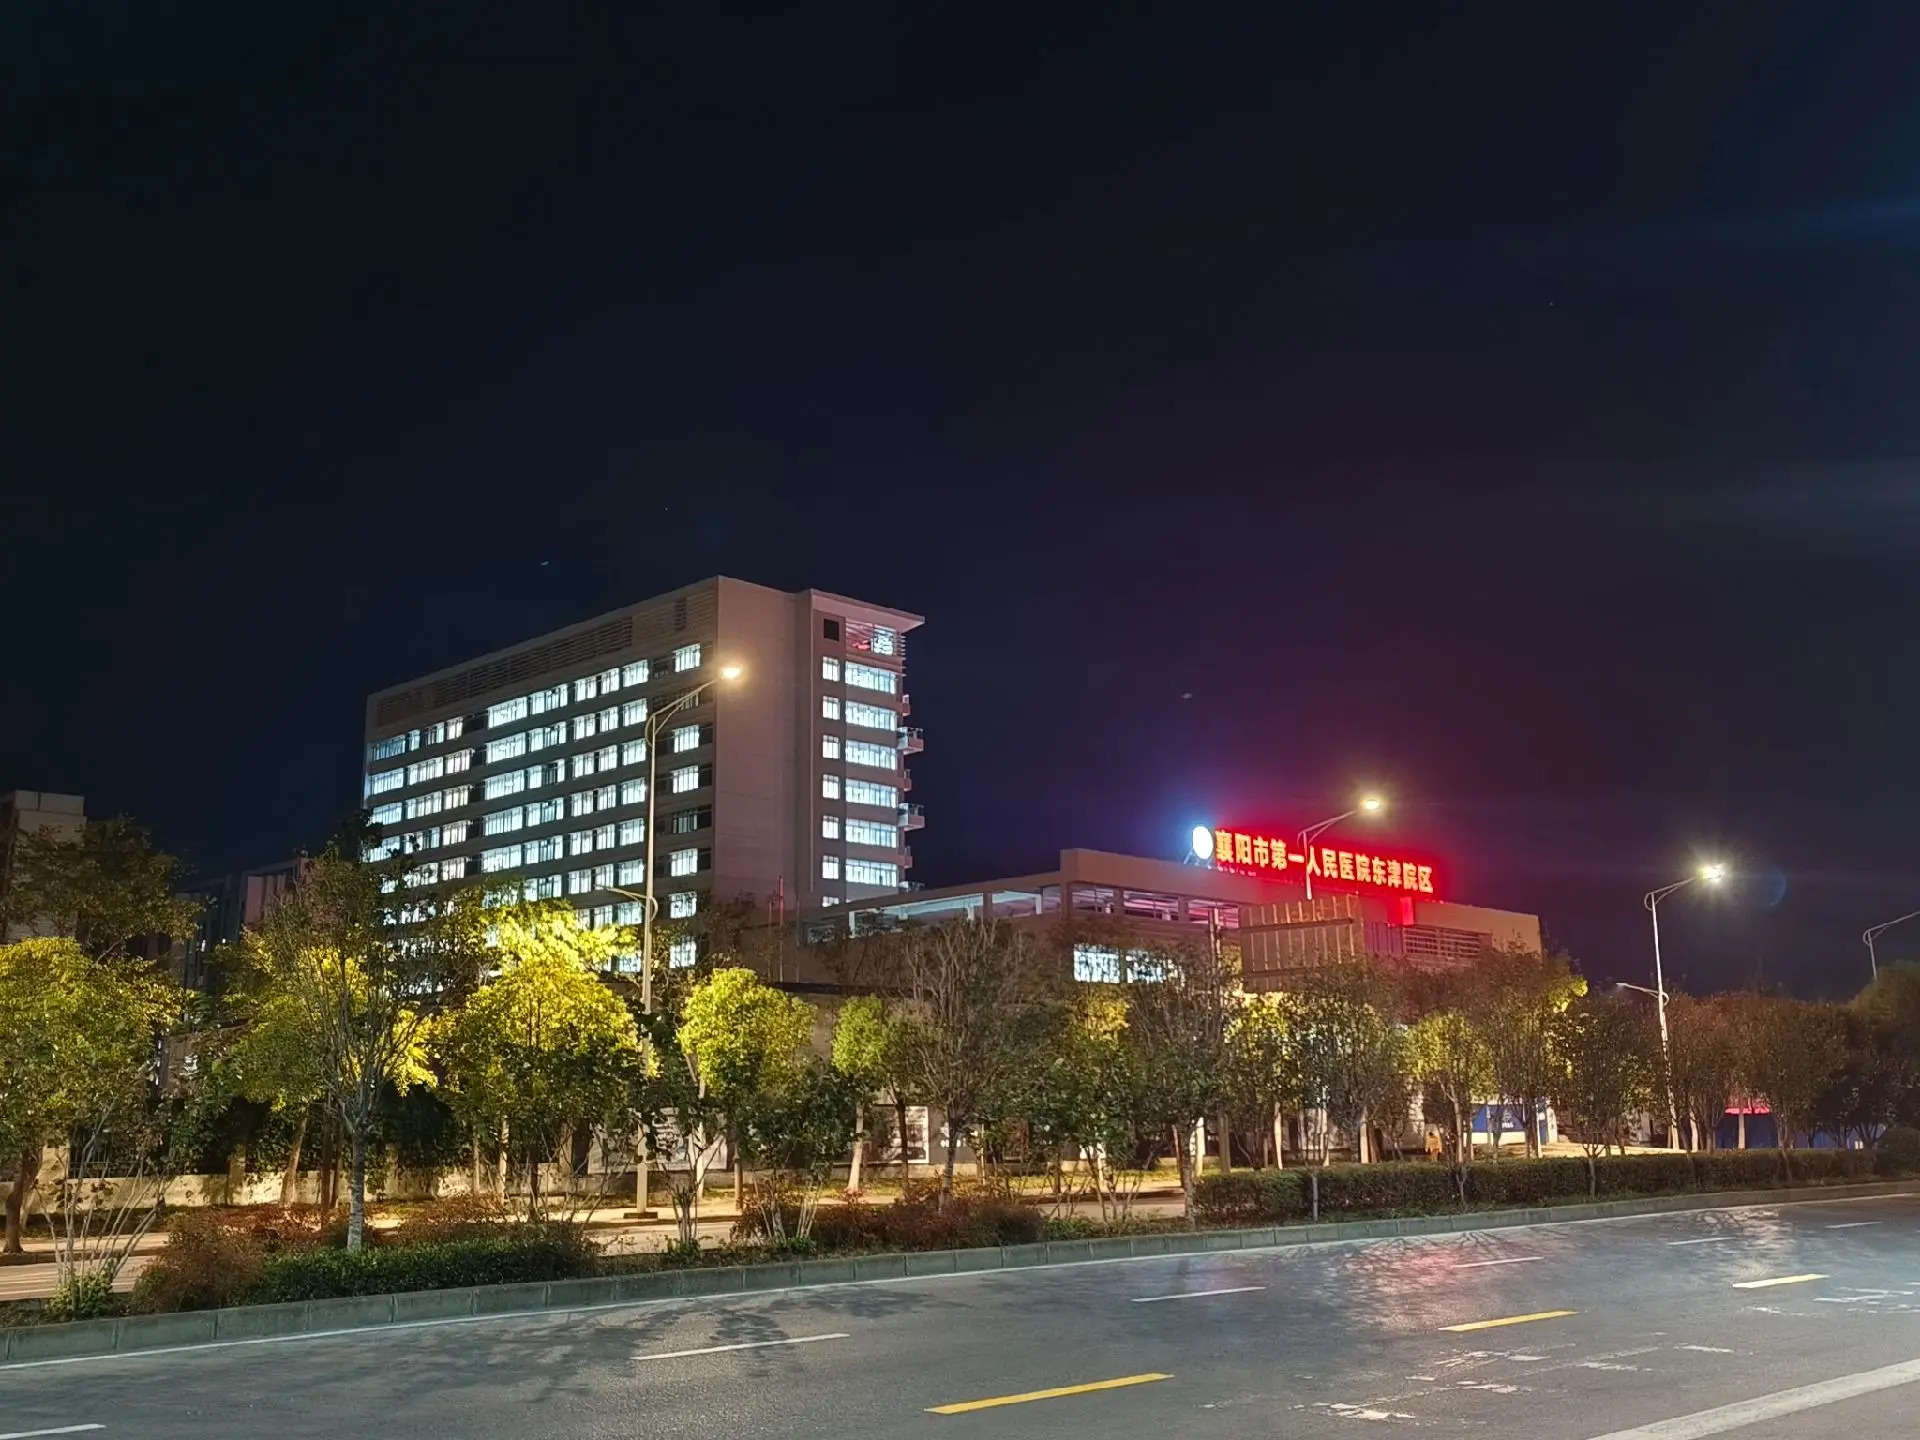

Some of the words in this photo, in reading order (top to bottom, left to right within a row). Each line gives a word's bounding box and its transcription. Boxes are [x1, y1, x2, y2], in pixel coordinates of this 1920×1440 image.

[1215, 829, 1433, 893] 襄阳市第一人民医院东津院区
